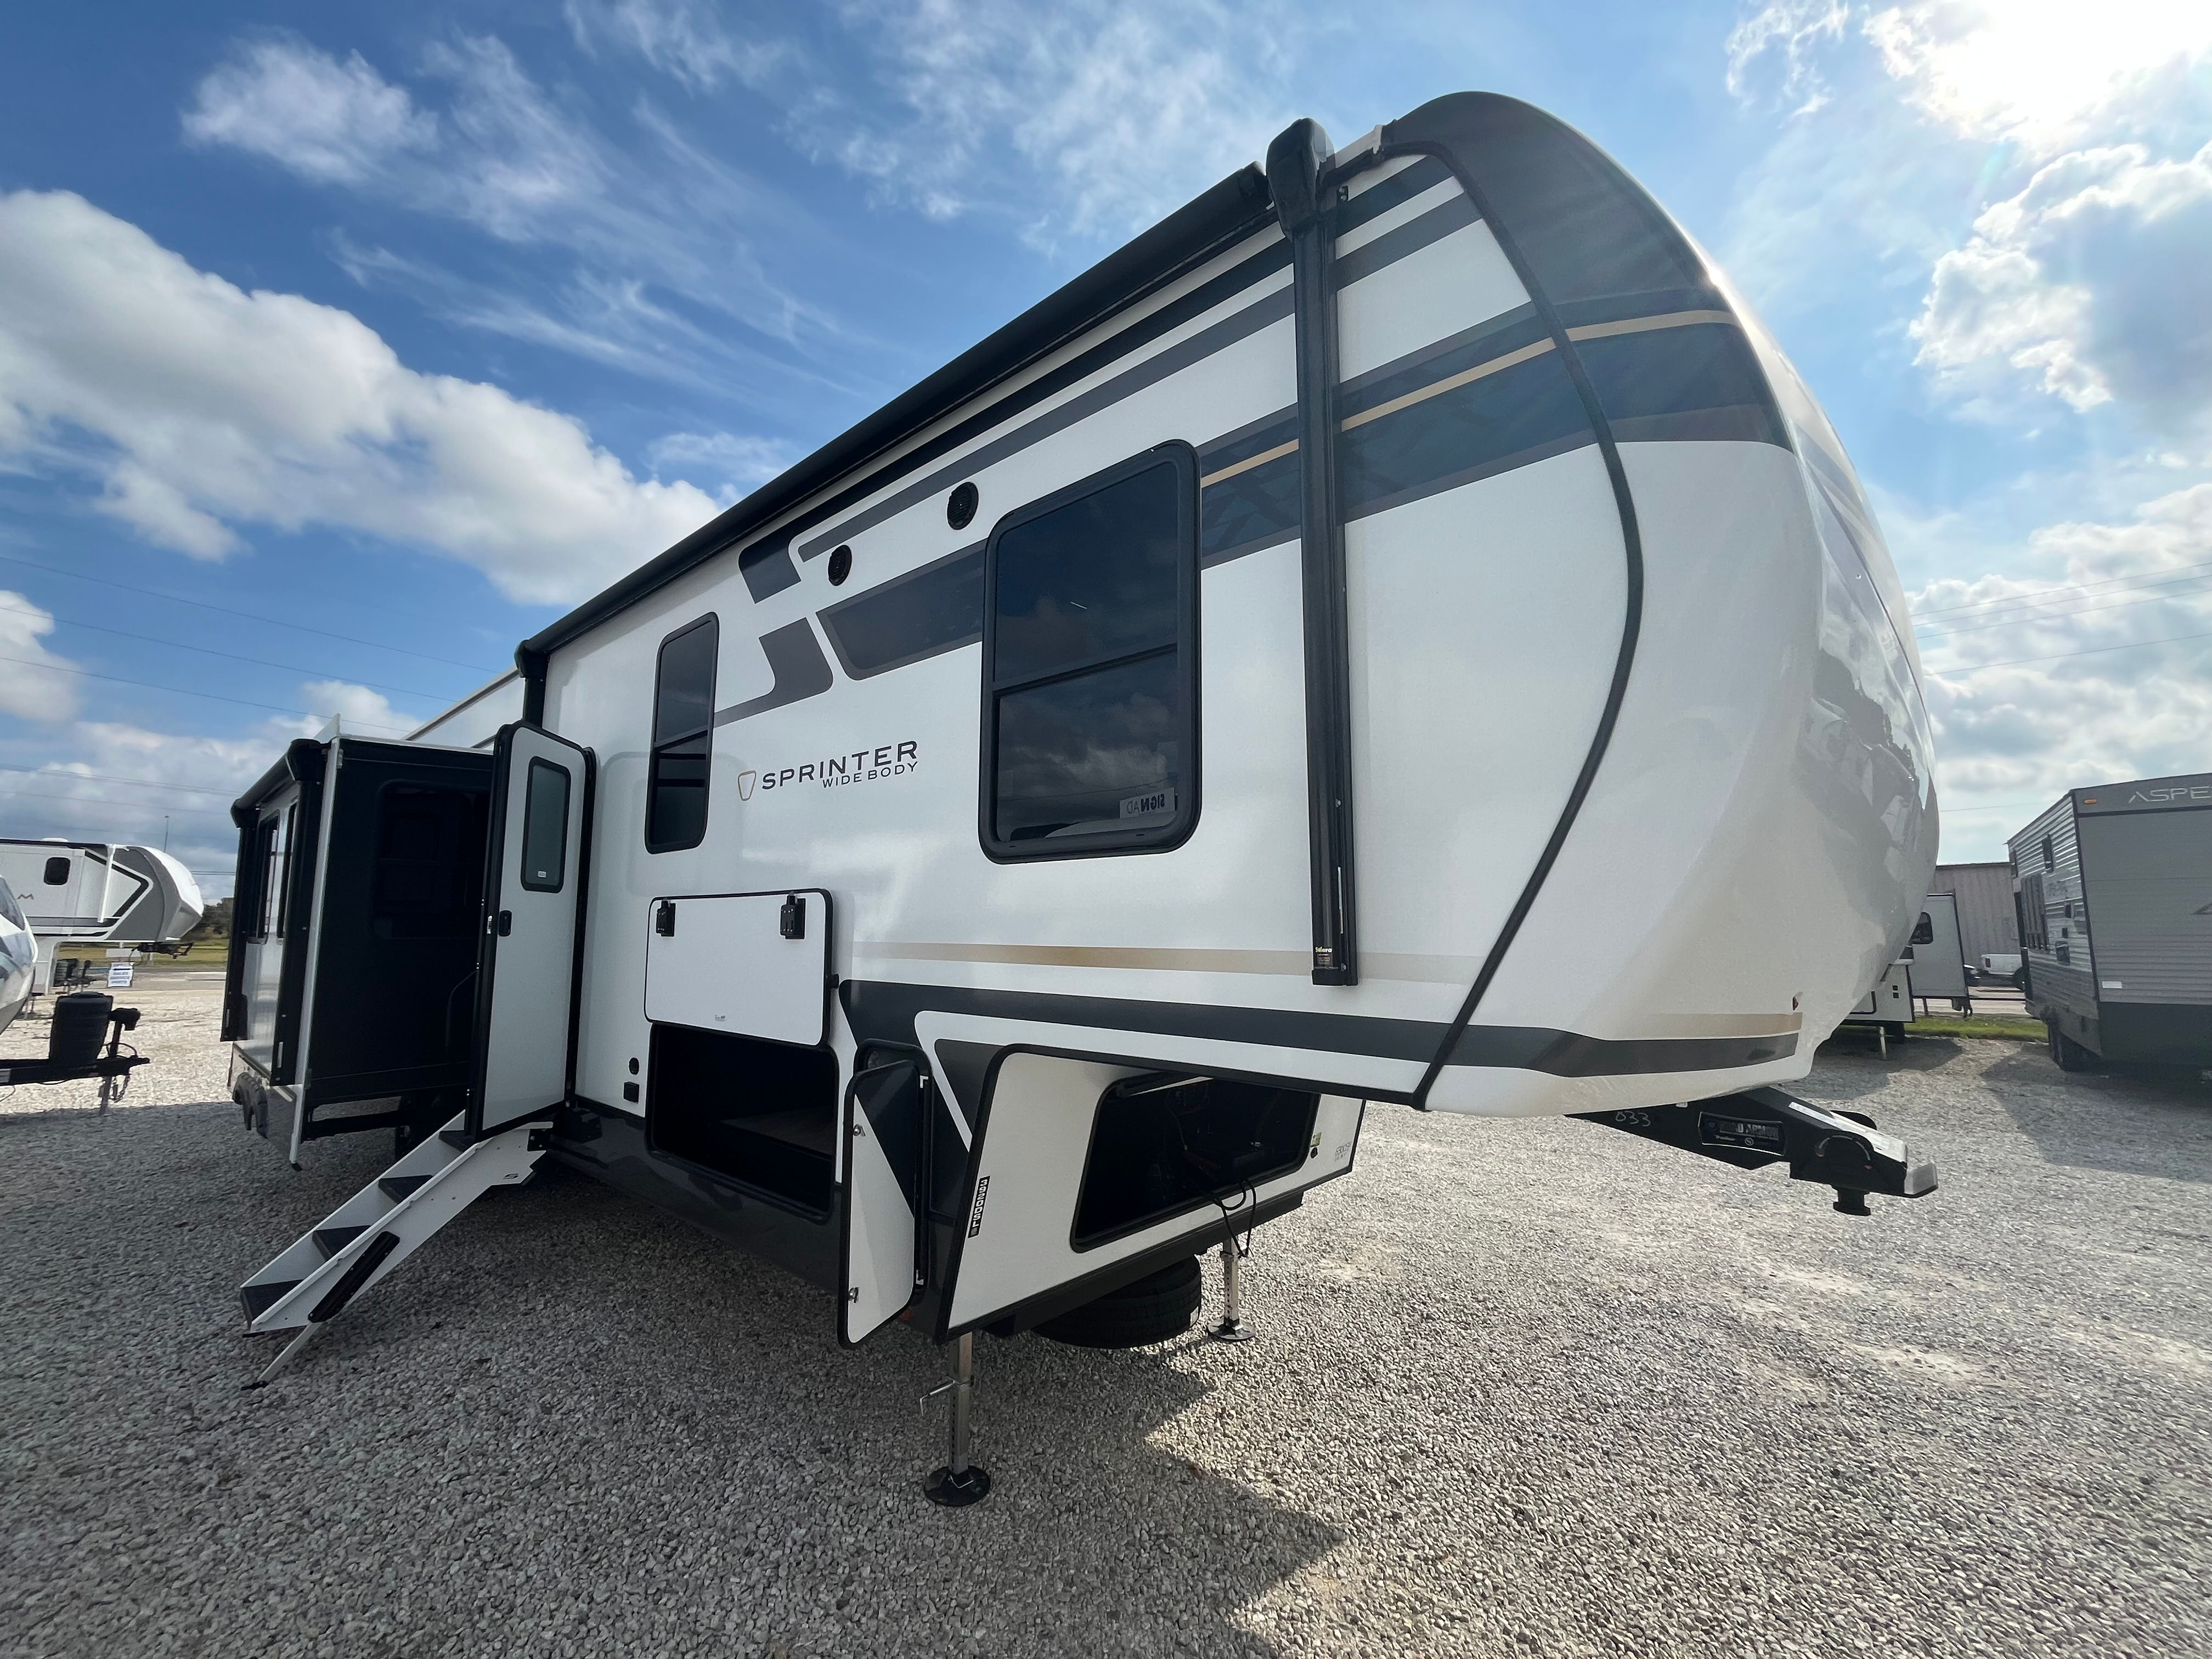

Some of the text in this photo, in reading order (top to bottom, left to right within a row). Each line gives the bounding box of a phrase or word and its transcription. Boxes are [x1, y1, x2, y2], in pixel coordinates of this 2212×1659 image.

[762, 740, 918, 790] SPRINTER
[822, 761, 918, 788] WIDE BODY
[2129, 785, 2212, 804] ASPE
